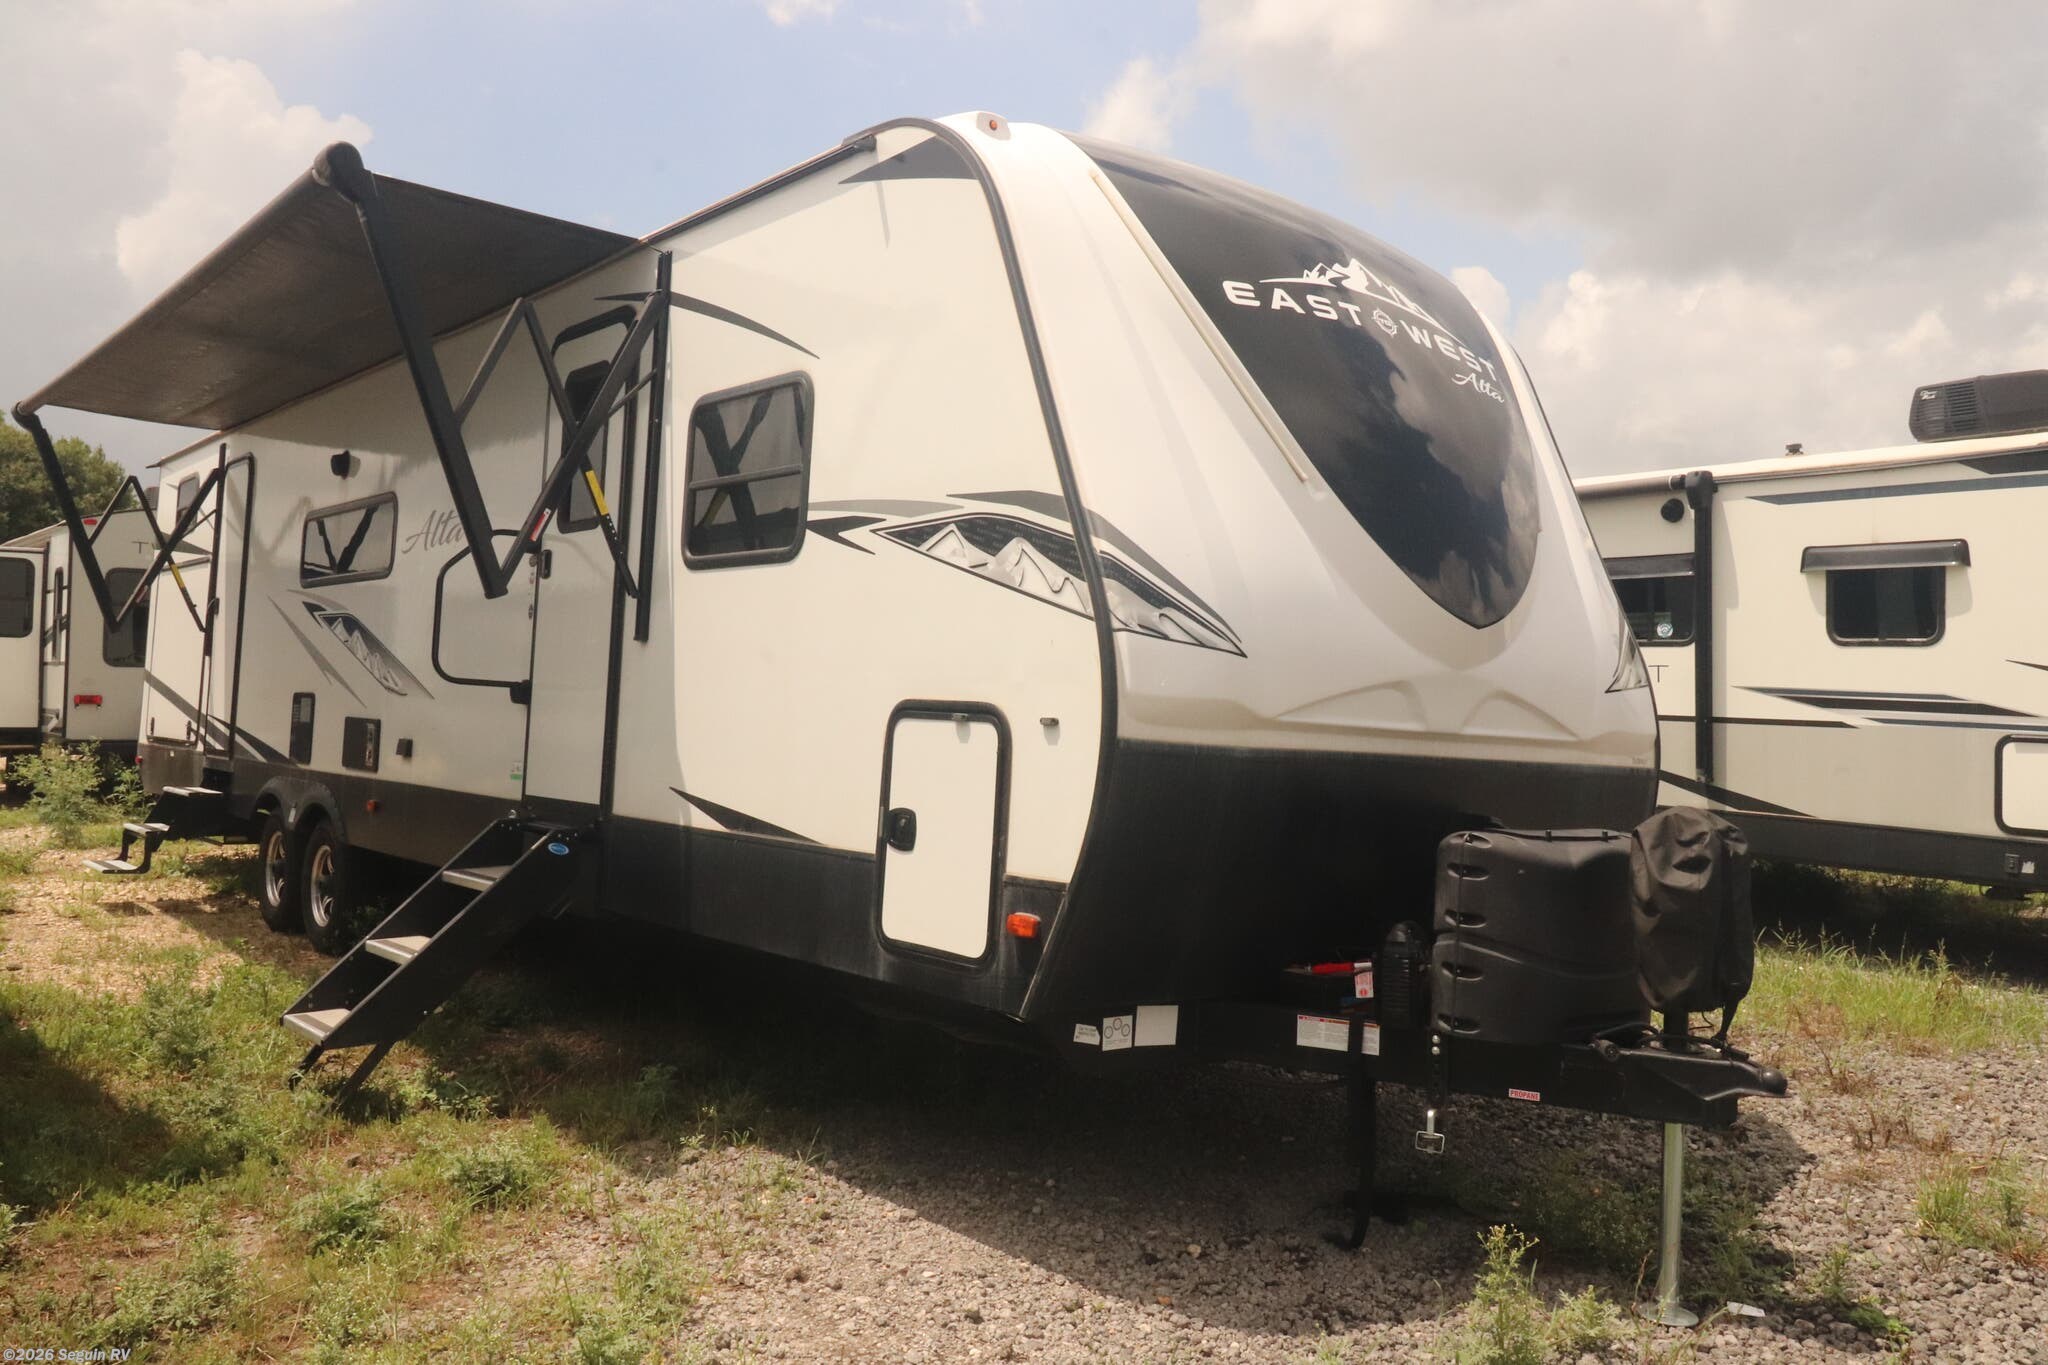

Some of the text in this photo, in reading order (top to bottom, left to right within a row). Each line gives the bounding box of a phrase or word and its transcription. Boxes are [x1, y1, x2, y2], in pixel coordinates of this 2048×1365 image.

[1222, 280, 1362, 326] EAST
[1399, 319, 1497, 382] WEST
[1451, 372, 1504, 404] Alta
[401, 509, 462, 555] Alta
